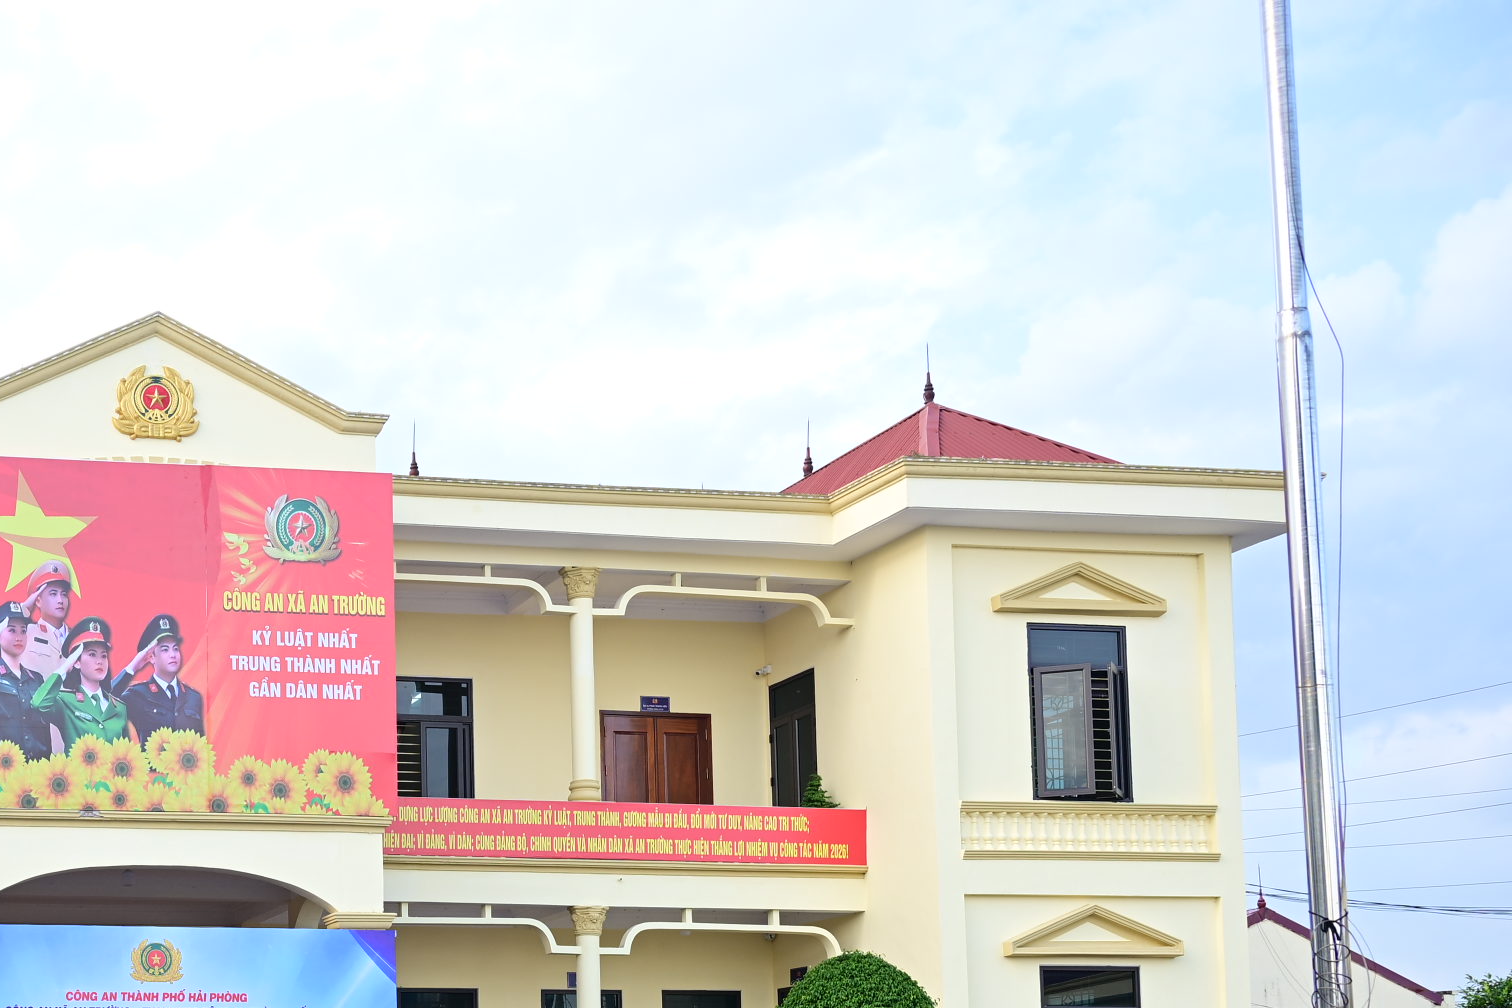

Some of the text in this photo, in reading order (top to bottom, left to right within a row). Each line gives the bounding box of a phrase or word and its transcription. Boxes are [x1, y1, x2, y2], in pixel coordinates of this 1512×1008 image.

[223, 588, 386, 616] CÔNG AN XÃ AN TRƯỜNG
[252, 626, 358, 650] KỶ LUẬT NHẤT
[229, 654, 381, 676] TRUNG THÀNH NHẤT
[249, 676, 363, 701] GẦN DÂN NHẤT
[399, 805, 419, 825] DỰNG
[420, 806, 434, 826] LỰC
[435, 806, 458, 827] LƯỢNG
[459, 805, 479, 824] CÔNG
[480, 809, 491, 824] AN
[491, 806, 502, 824] XÃ
[503, 809, 513, 825] AN
[515, 806, 542, 825] TRƯỜNG
[543, 805, 553, 826] KỶ
[554, 808, 571, 829] LUẬT,
[573, 811, 596, 826] TRUNG
[597, 808, 622, 829] THÀNH,
[623, 811, 647, 828] GƯƠNG
[665, 812, 673, 828] ĐI
[703, 811, 717, 830] MỚI
[718, 813, 728, 830] TƯ
[743, 812, 763, 831] NÂNG
[764, 816, 778, 831] CAO
[778, 816, 790, 832] TRI
[417, 830, 425, 849] VÌ
[448, 831, 457, 850] VÌ
[475, 832, 495, 850] CÙNG
[496, 830, 516, 851] ĐẢNG
[517, 832, 529, 854] BỘ,
[530, 833, 551, 852] CHÍNH
[577, 834, 587, 853] VÀ
[588, 834, 607, 853] NHÂN
[608, 834, 623, 853] DÂN
[624, 835, 634, 854] XÃ
[635, 838, 645, 854] AN
[646, 835, 674, 855] TRƯỜNG
[674, 838, 692, 858] THỰC
[693, 837, 710, 859] HIỆN
[711, 835, 733, 856] THẮNG
[734, 839, 745, 860] LỢI
[746, 838, 768, 860] NHIỆM
[769, 842, 778, 861] VỤ
[779, 839, 798, 858] CÔNG
[799, 840, 812, 858] TÁC
[813, 840, 829, 859] NĂM
[830, 844, 849, 859] 2026!
[65, 989, 248, 1003] CÔNG AN THÀNH PHỐ HẢI PHÒNG
